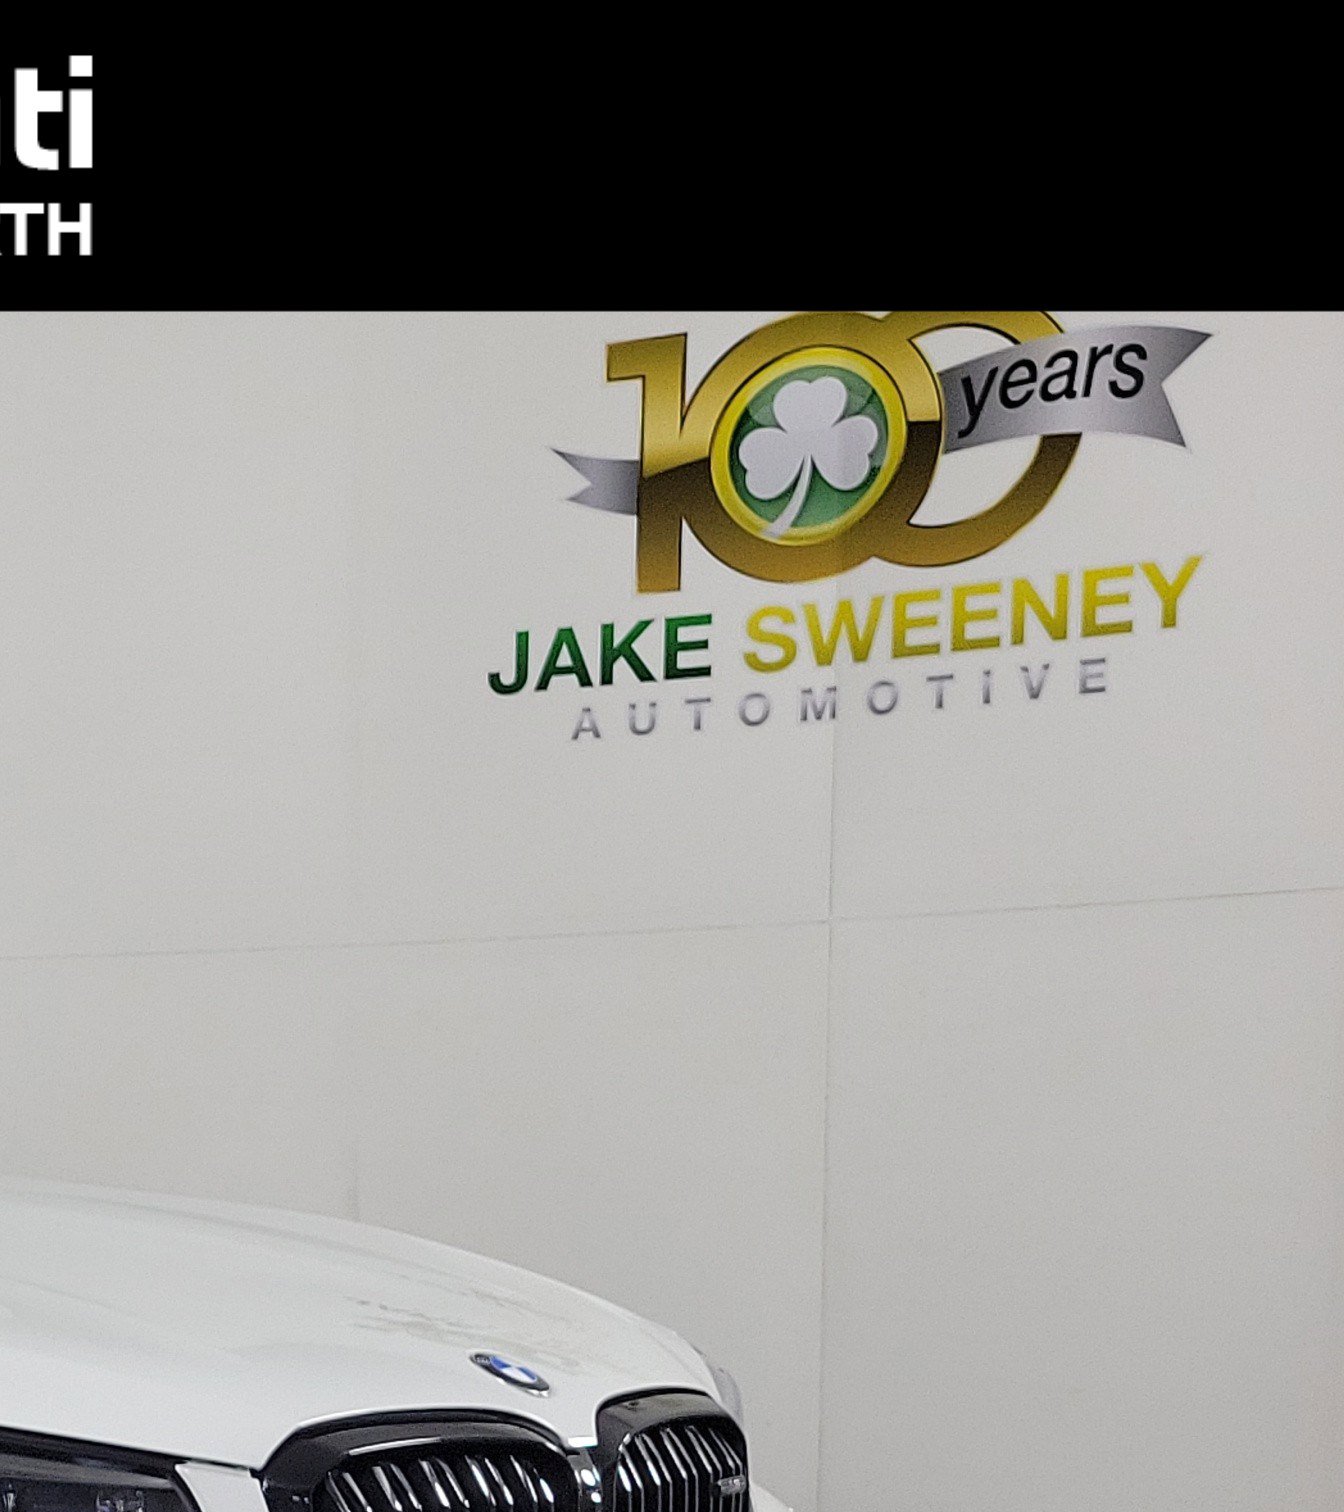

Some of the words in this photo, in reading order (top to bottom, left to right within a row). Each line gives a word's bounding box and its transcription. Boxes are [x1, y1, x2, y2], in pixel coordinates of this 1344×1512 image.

[957, 342, 1148, 438] years
[488, 613, 712, 695] JAKE
[743, 556, 1203, 673] SWEENEY
[571, 658, 1108, 741] AUTOMOTIVE
